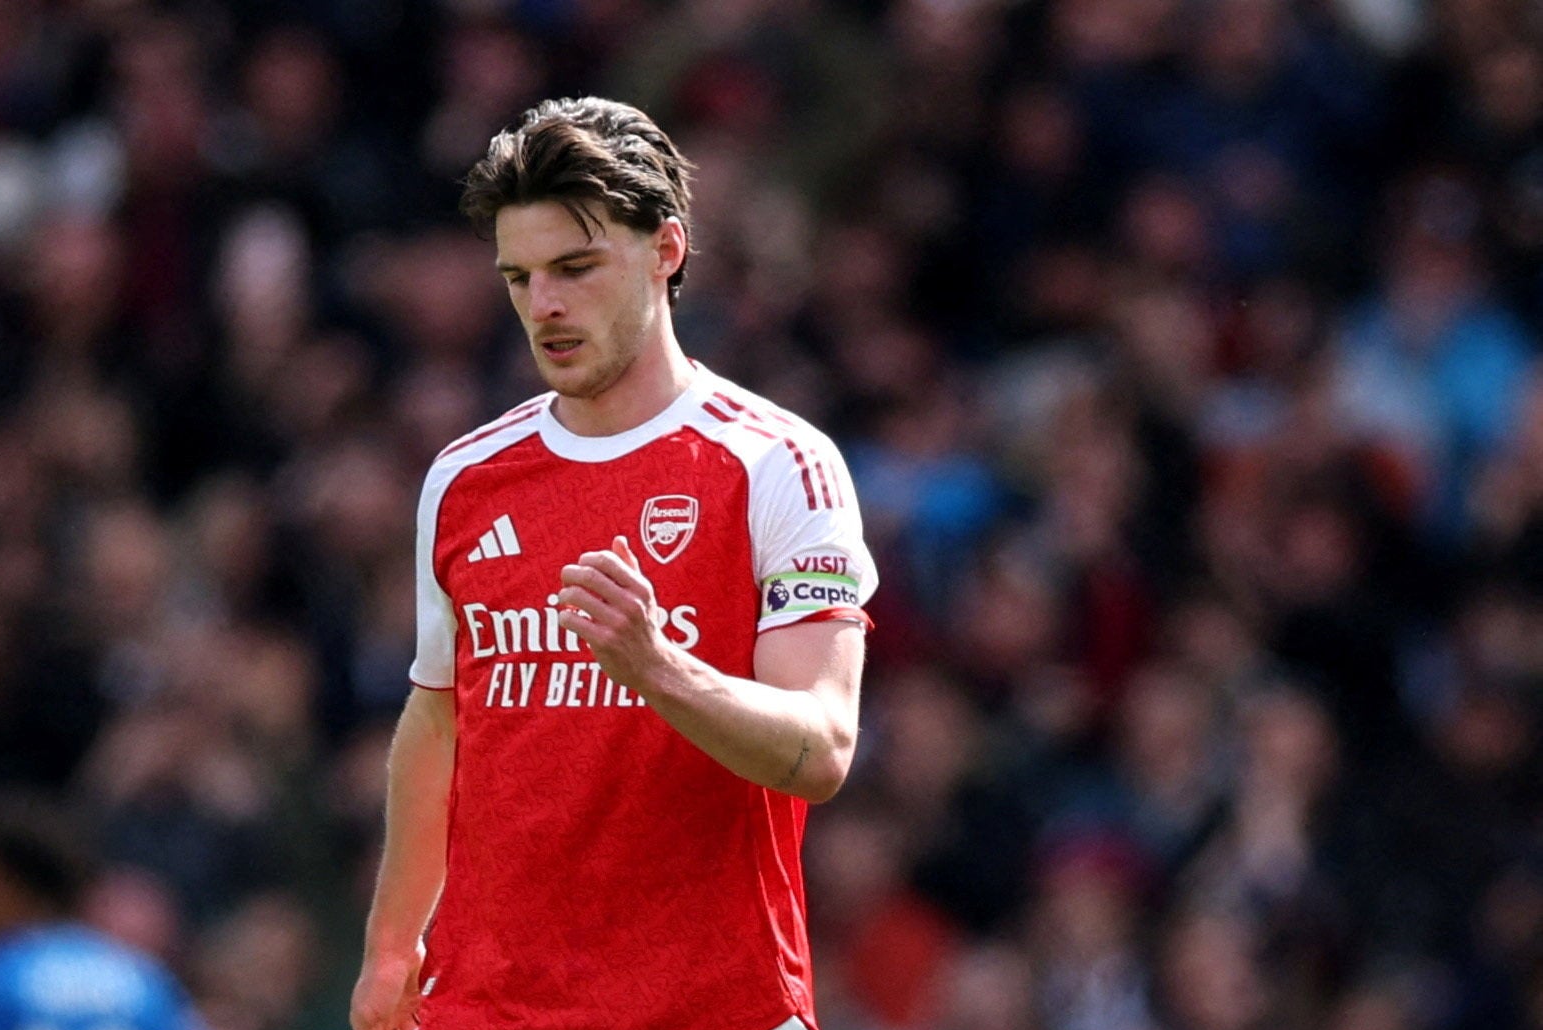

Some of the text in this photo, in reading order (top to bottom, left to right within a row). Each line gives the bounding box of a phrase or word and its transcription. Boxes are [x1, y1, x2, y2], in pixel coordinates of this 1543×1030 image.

[650, 507, 691, 518] Arsenal
[792, 556, 848, 576] VISIT
[486, 662, 537, 707] FLY
